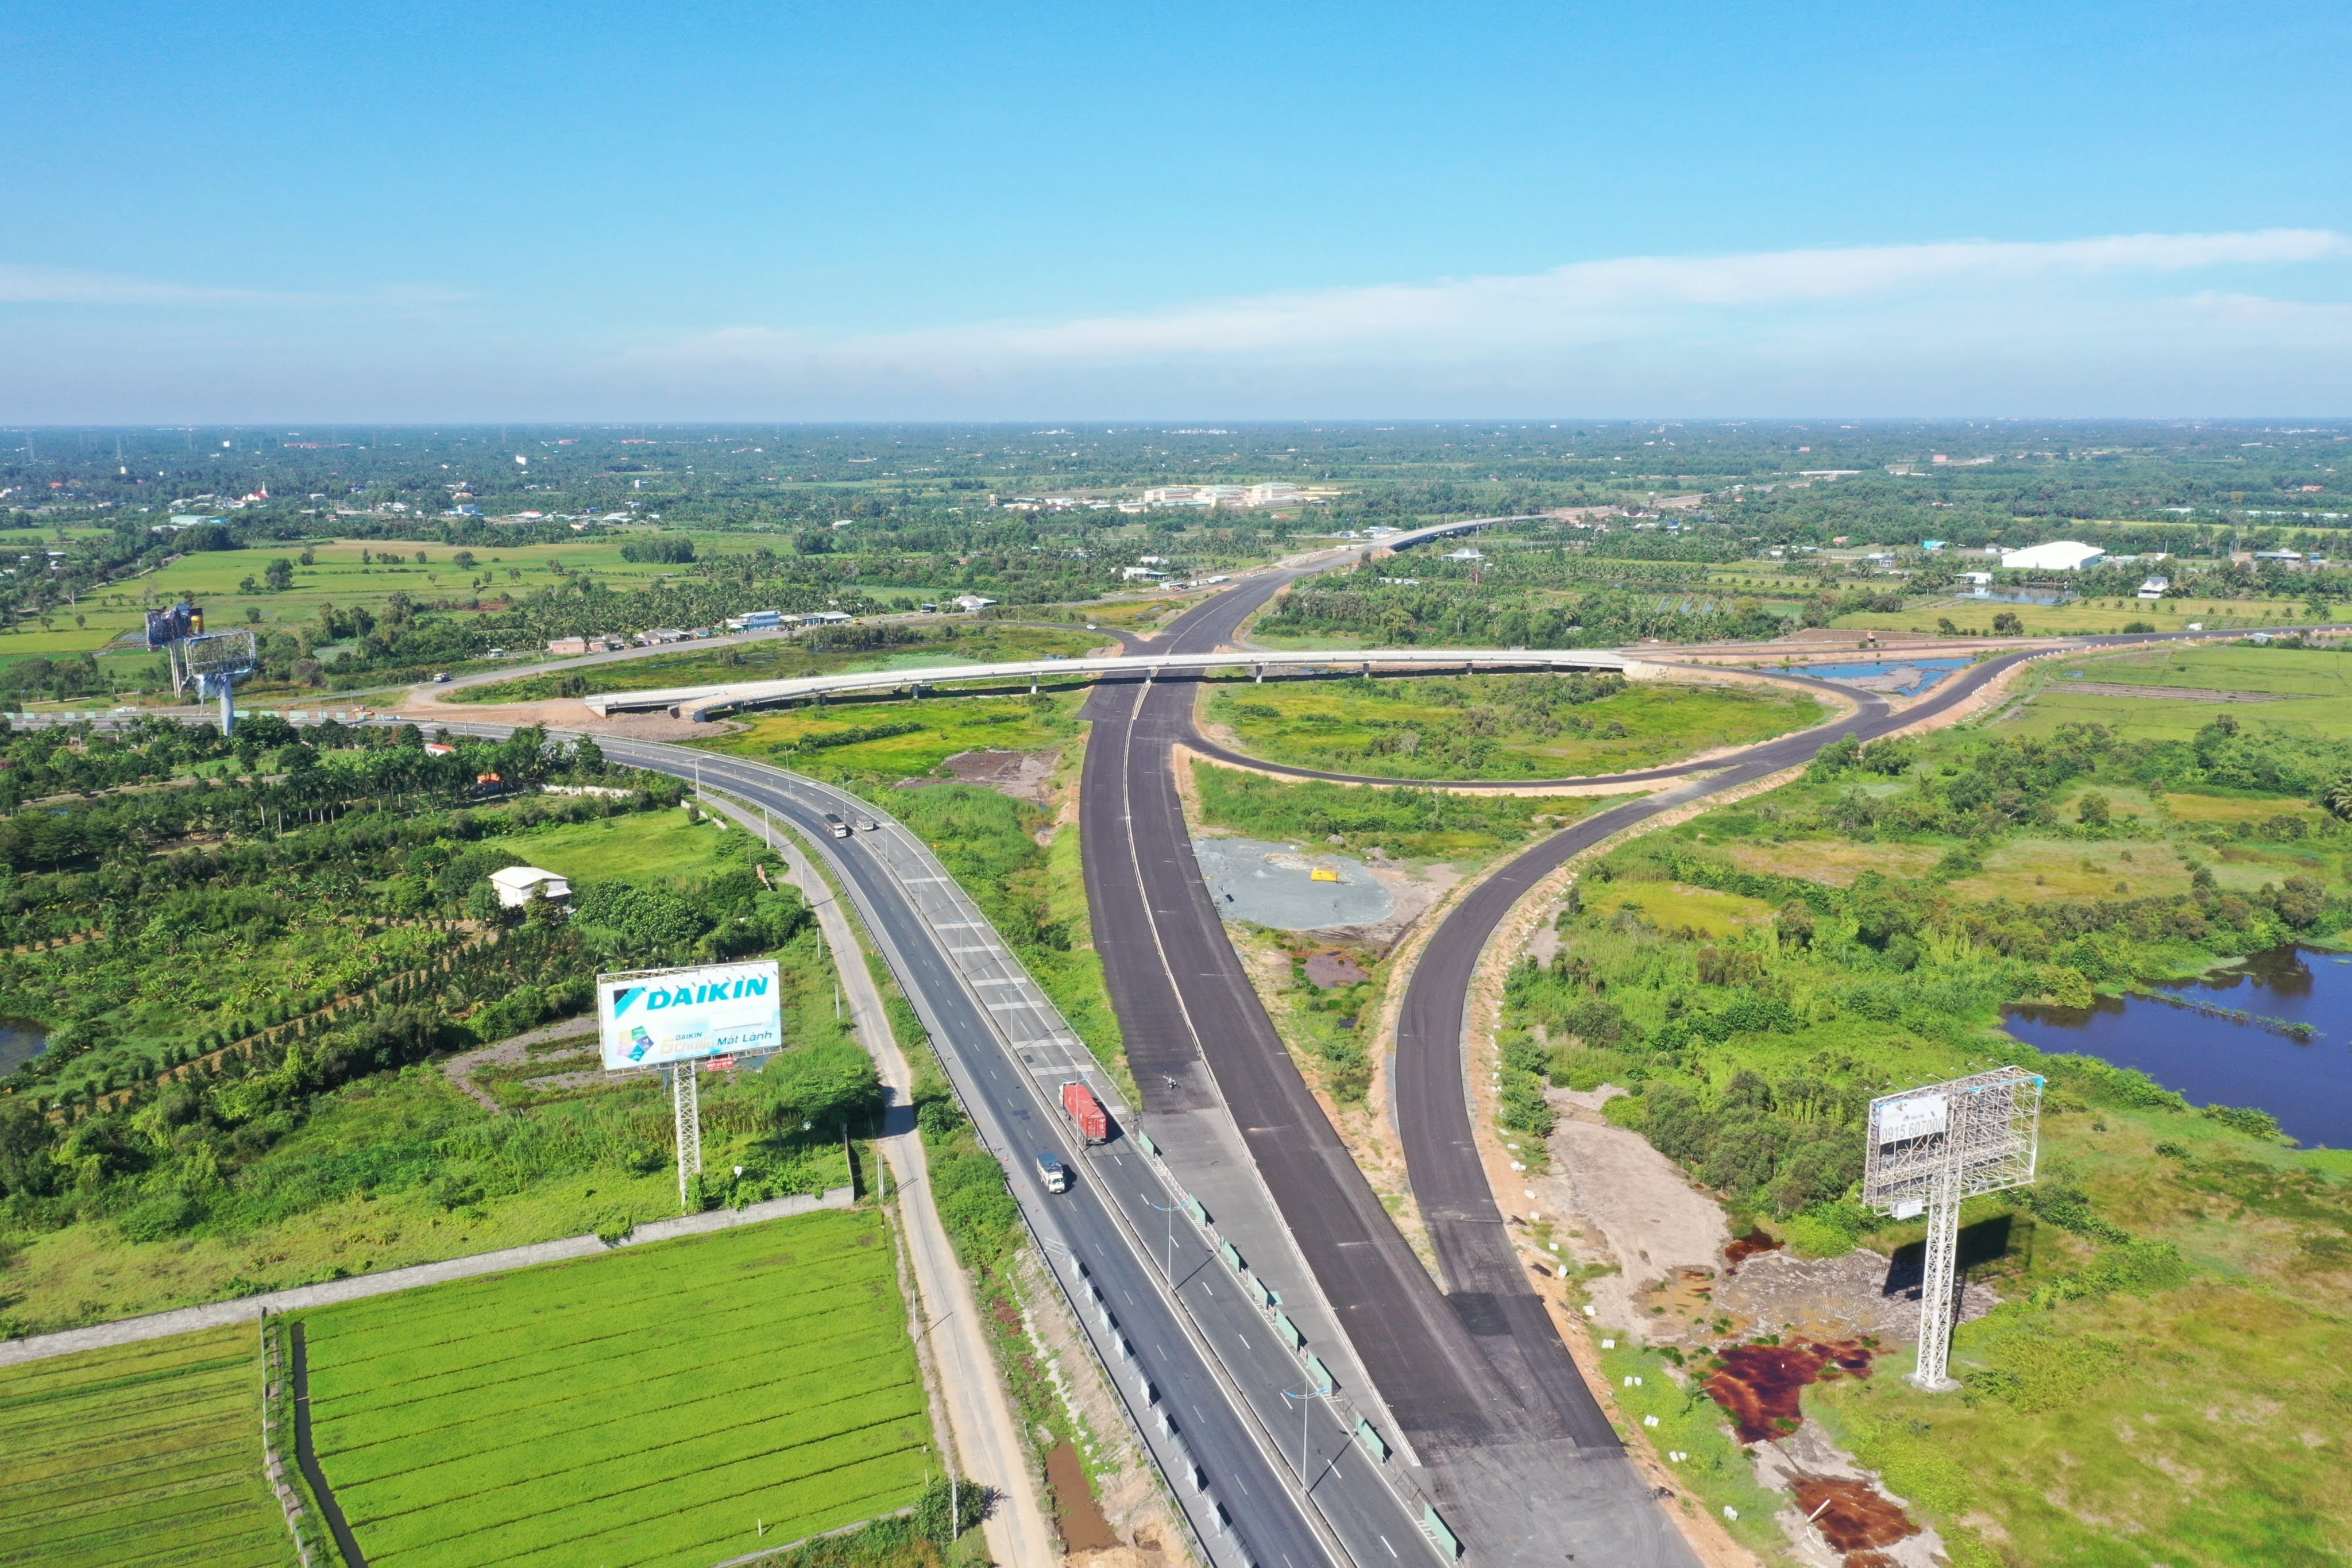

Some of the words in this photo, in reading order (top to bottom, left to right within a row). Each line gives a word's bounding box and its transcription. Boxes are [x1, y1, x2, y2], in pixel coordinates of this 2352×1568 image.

[647, 977, 768, 1010] DAIKIN
[675, 1032, 702, 1041] DAIKIN
[1882, 1124, 1905, 1142] 0915
[1909, 1117, 1944, 1137] 607000
